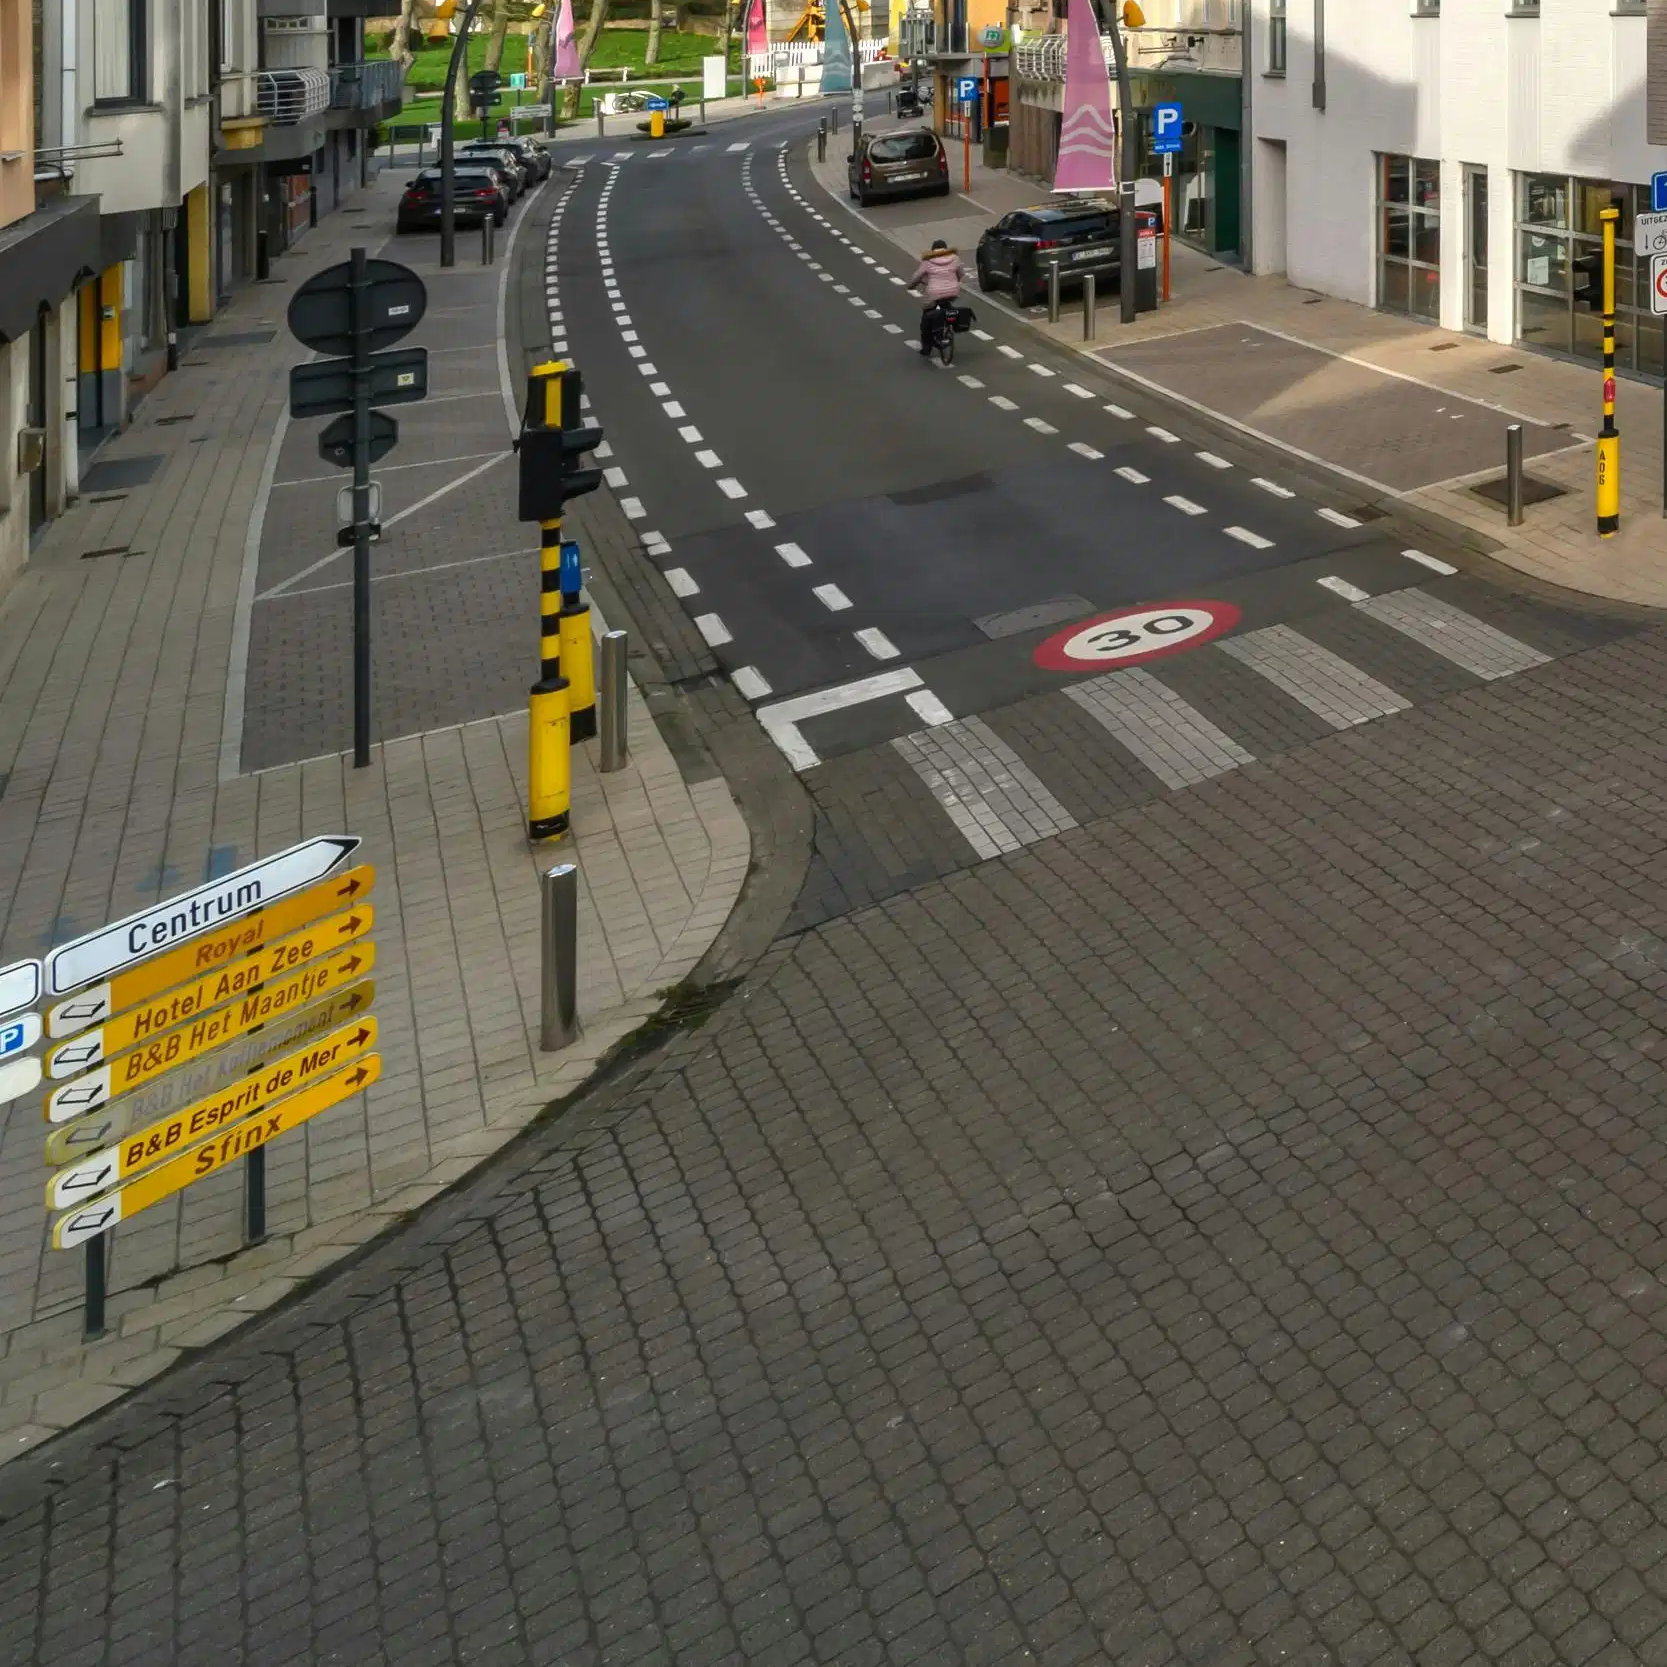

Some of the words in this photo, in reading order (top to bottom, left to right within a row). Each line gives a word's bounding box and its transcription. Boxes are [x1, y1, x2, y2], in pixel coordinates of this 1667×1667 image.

[960, 80, 974, 97] P
[1158, 109, 1178, 134] P
[1087, 615, 1194, 652] 30
[128, 879, 262, 955] Centrum
[196, 920, 265, 969] Royal
[133, 992, 201, 1038] Hotel
[215, 963, 260, 997] Aan
[272, 941, 314, 973] Zee
[0, 1027, 19, 1053] P
[126, 1034, 181, 1082] B&B
[189, 1009, 232, 1051] Het
[240, 965, 329, 1028] Maantje
[126, 1121, 181, 1168] B&B
[189, 1082, 260, 1135] Esprit
[266, 1069, 293, 1094] de
[299, 1044, 341, 1078] Mer
[195, 1114, 282, 1176] Sfinx
